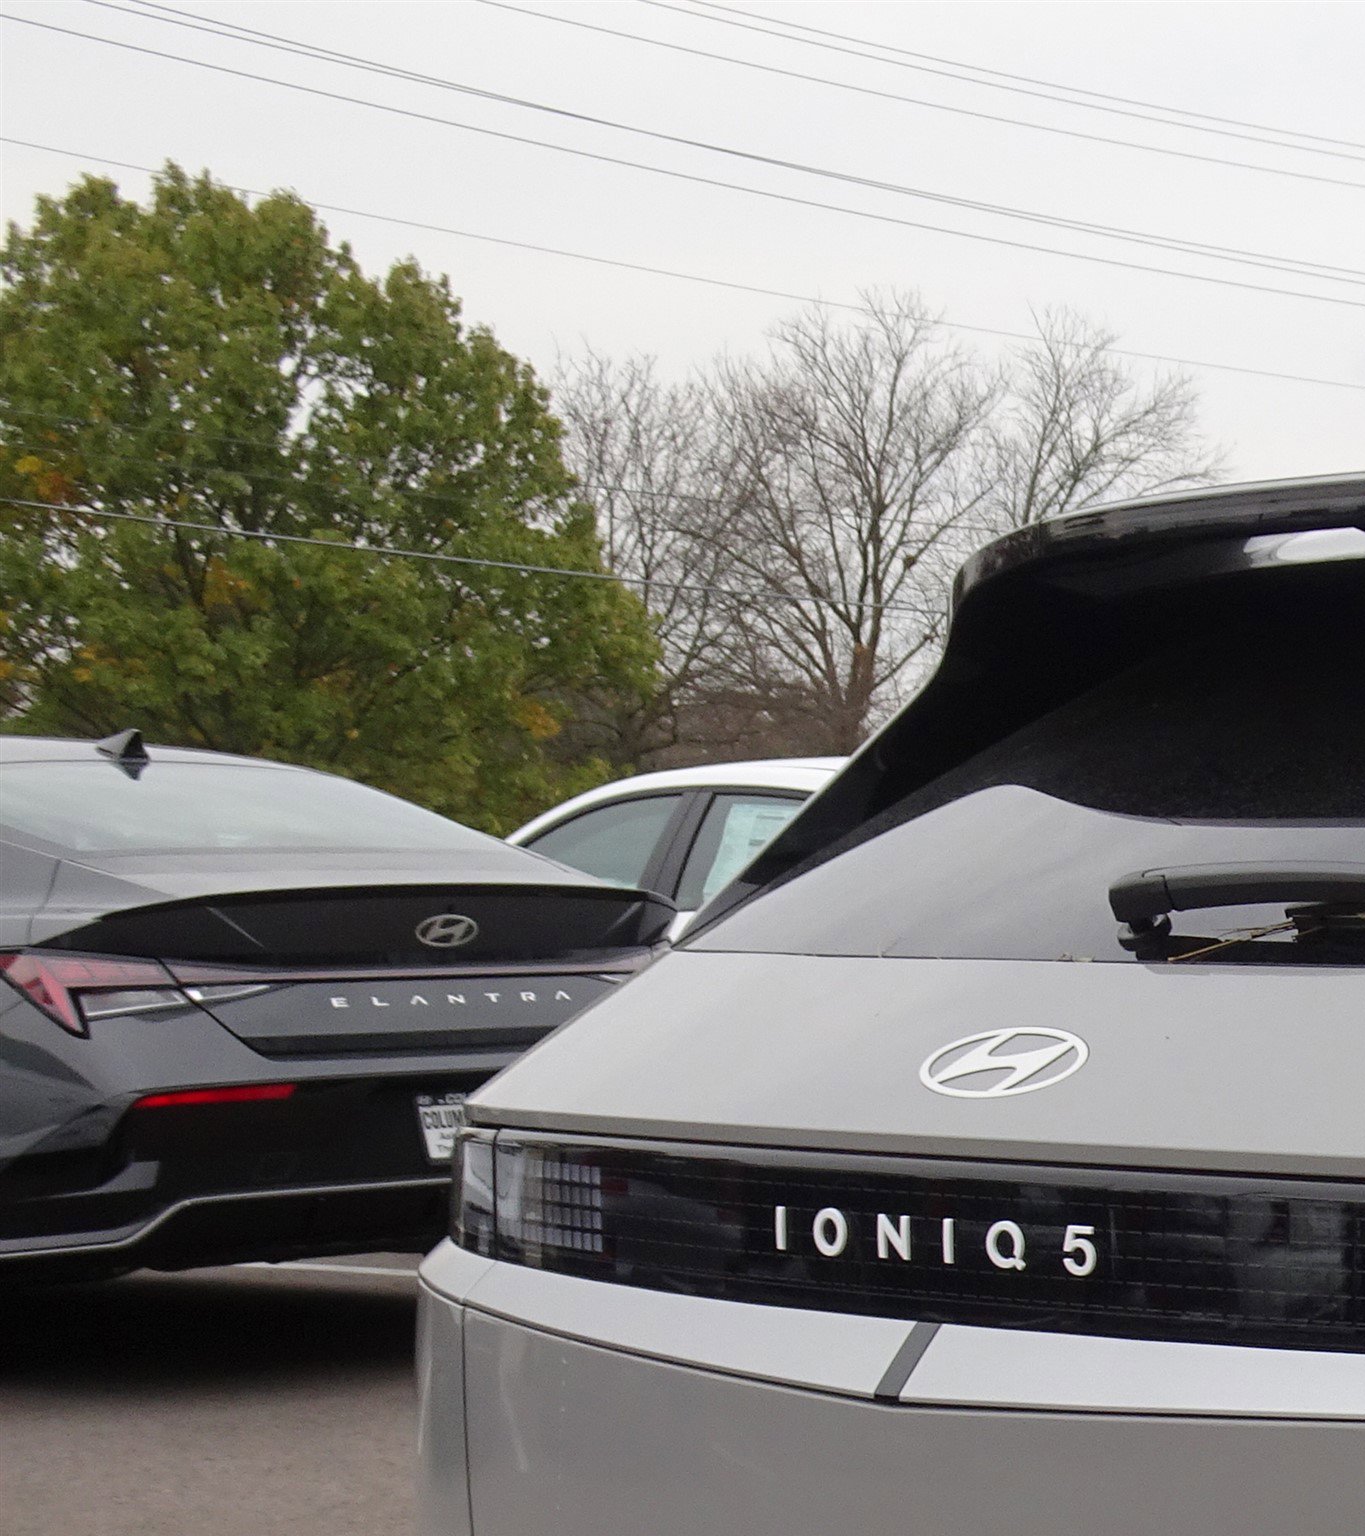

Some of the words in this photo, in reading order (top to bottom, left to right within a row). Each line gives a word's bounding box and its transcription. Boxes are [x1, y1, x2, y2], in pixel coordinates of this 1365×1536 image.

[330, 989, 572, 1008] ELANTRA
[774, 1205, 1026, 1271] IONIQ
[1062, 1225, 1098, 1277] 5
